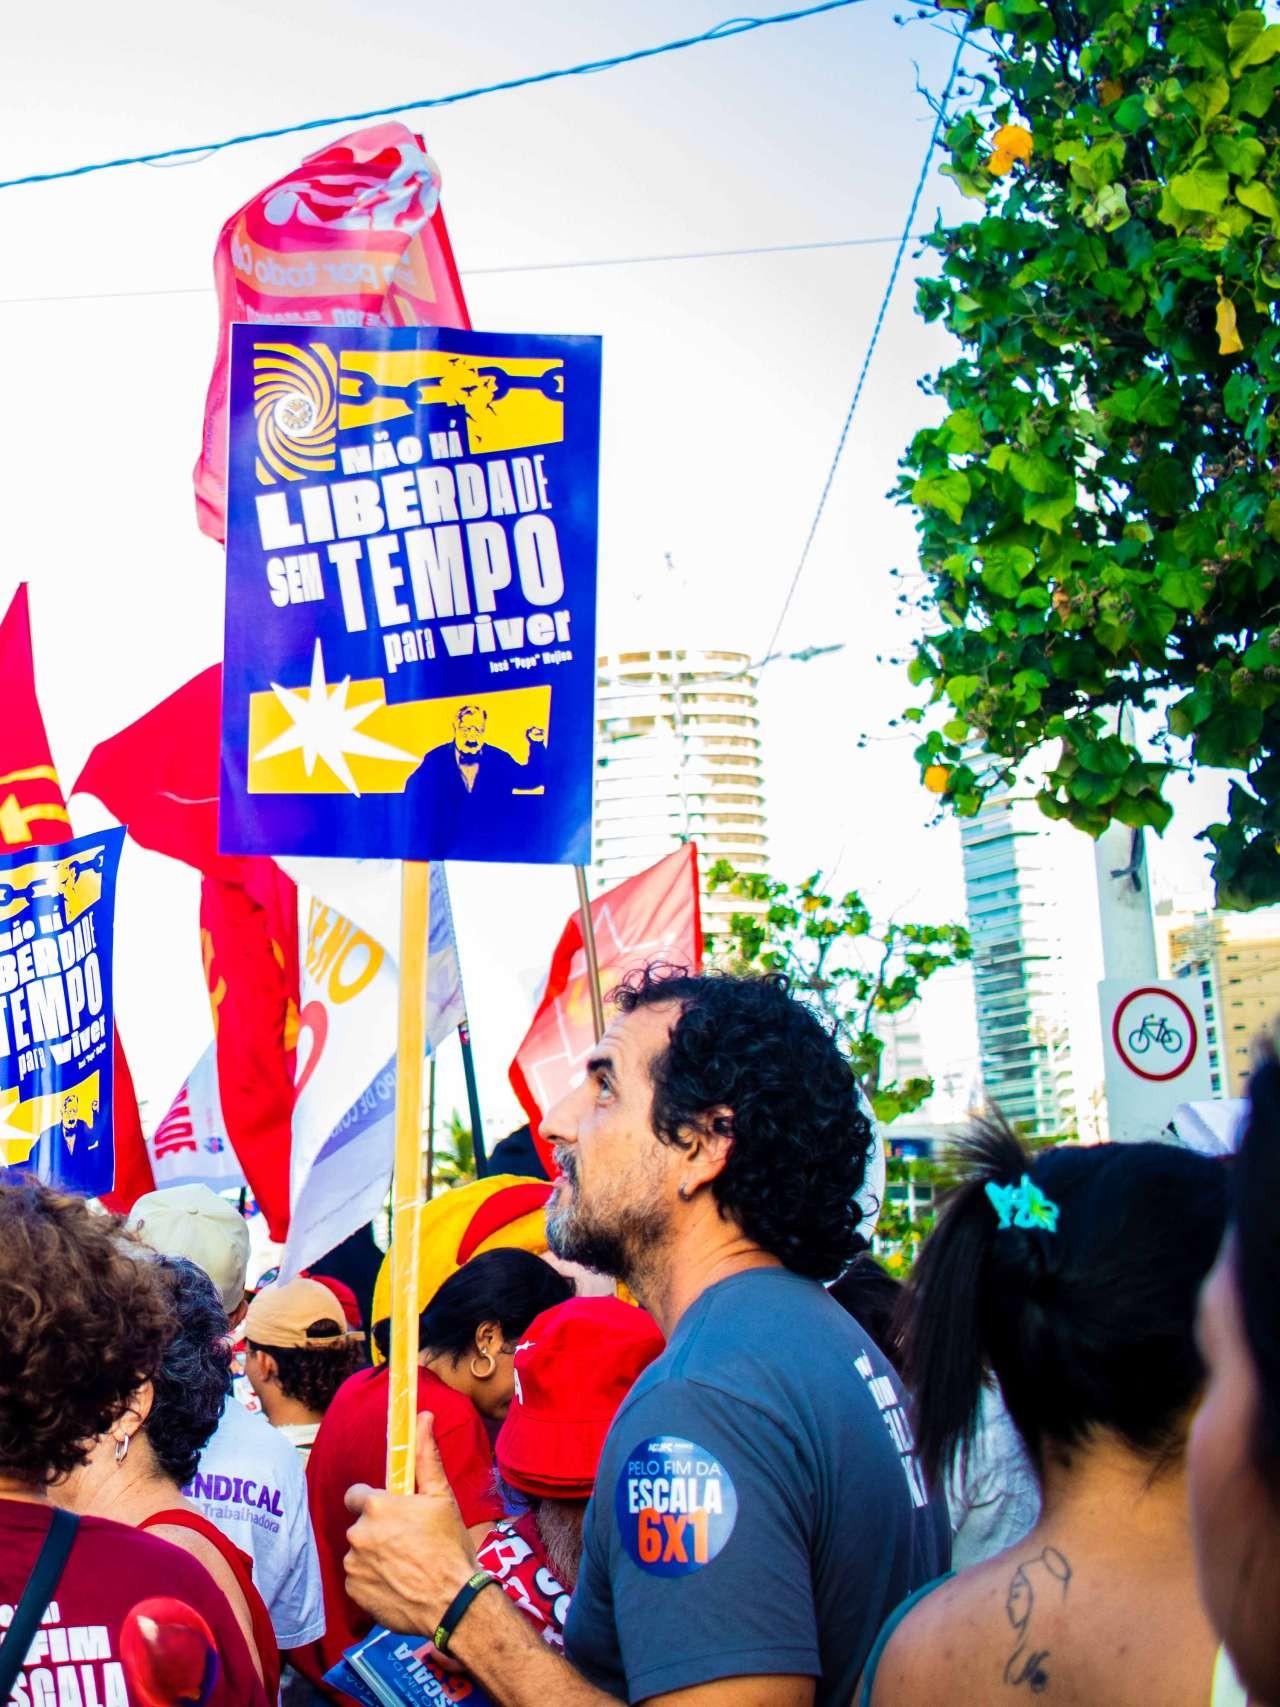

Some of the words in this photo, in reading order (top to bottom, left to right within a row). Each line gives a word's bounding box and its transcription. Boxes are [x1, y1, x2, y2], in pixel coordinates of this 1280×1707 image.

[341, 431, 422, 475] NÃO
[429, 419, 464, 460] HÁ
[255, 453, 552, 551] LIBERDADE
[266, 552, 325, 608] SEM
[328, 514, 565, 633] TEMPO
[383, 627, 436, 674] para
[439, 609, 571, 657] viver
[18, 1047, 47, 1082] para
[49, 1014, 106, 1066] viver
[628, 1460, 660, 1476] PELO
[664, 1460, 691, 1475] FIM
[696, 1461, 722, 1476] DA
[181, 1472, 284, 1518] NDICAL
[628, 1477, 723, 1515] ESCALA
[23, 1625, 112, 1666] FIM
[8, 1662, 130, 1707] SCALA
